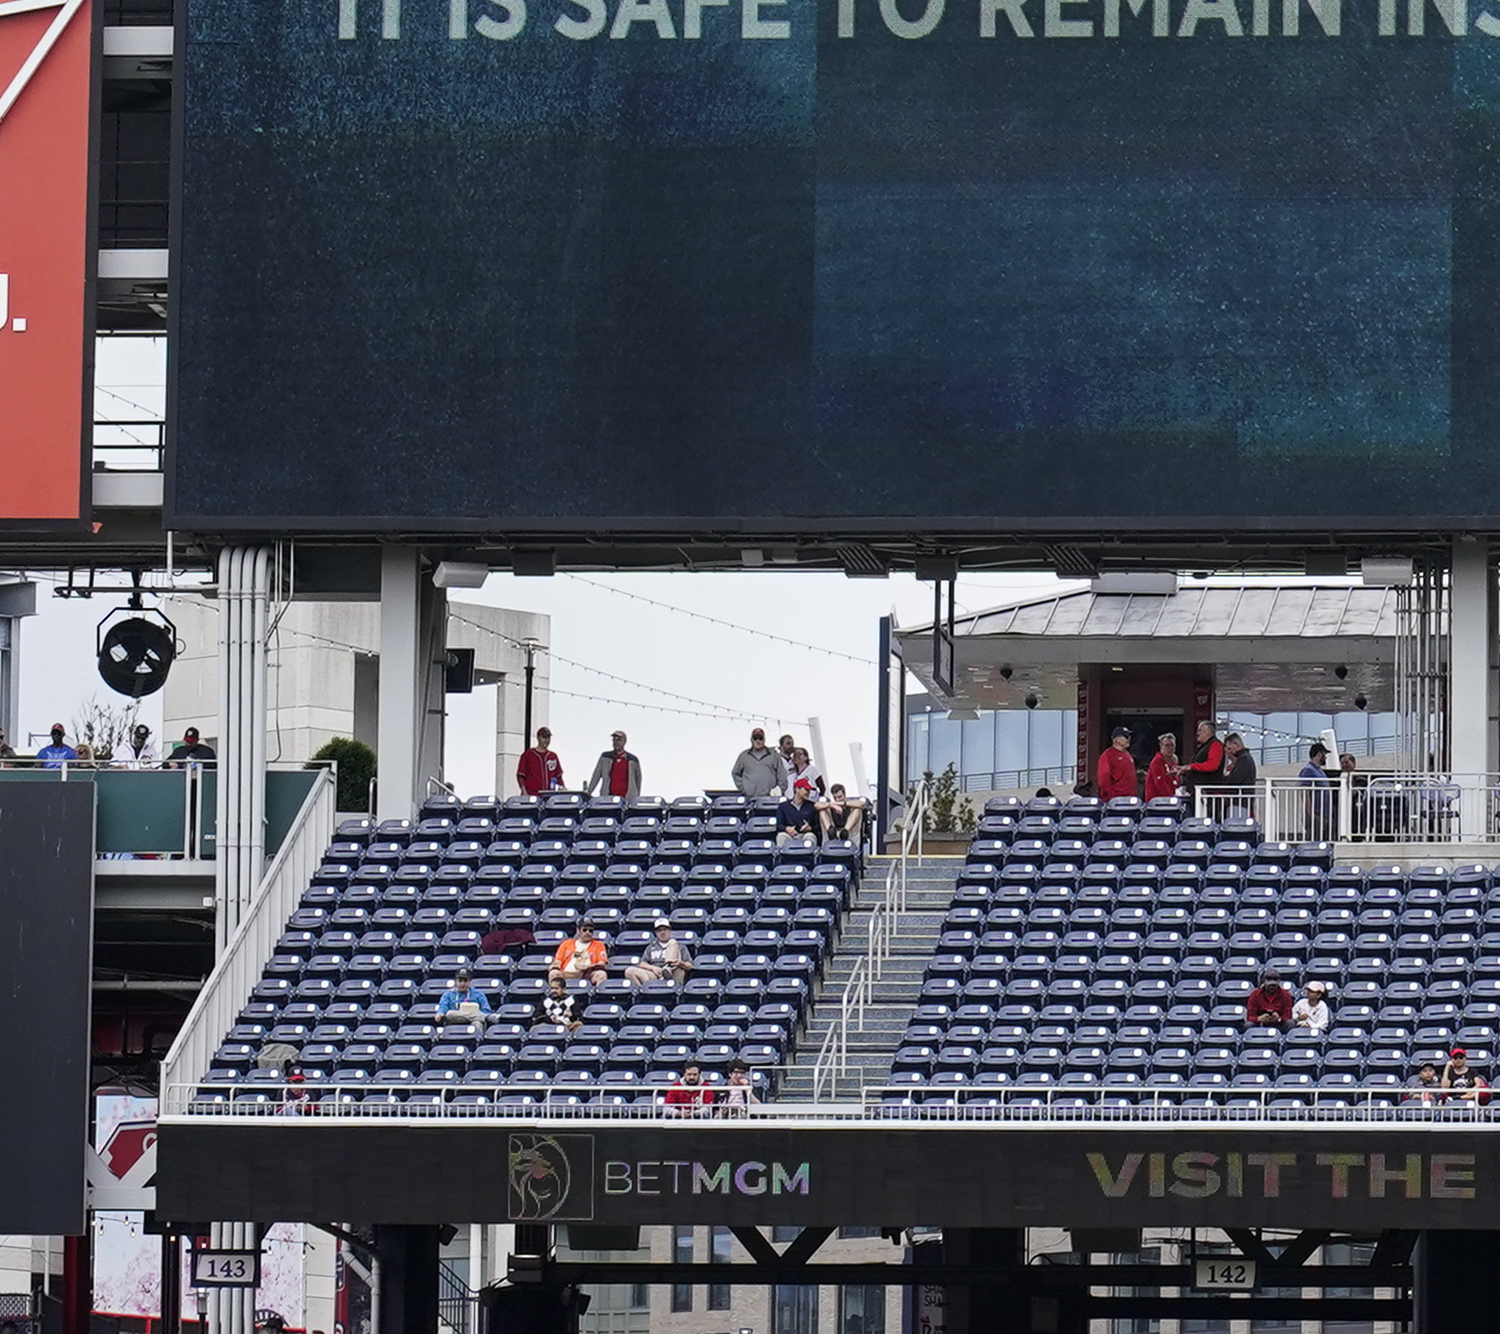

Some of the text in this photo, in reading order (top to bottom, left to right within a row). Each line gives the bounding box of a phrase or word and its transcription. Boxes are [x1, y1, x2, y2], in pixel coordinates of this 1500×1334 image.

[604, 1160, 810, 1197] BETMGM
[1084, 1153, 1301, 1200] VISIT
[1316, 1153, 1477, 1201] THE
[206, 1259, 247, 1279] 143
[1207, 1264, 1247, 1284] 142
